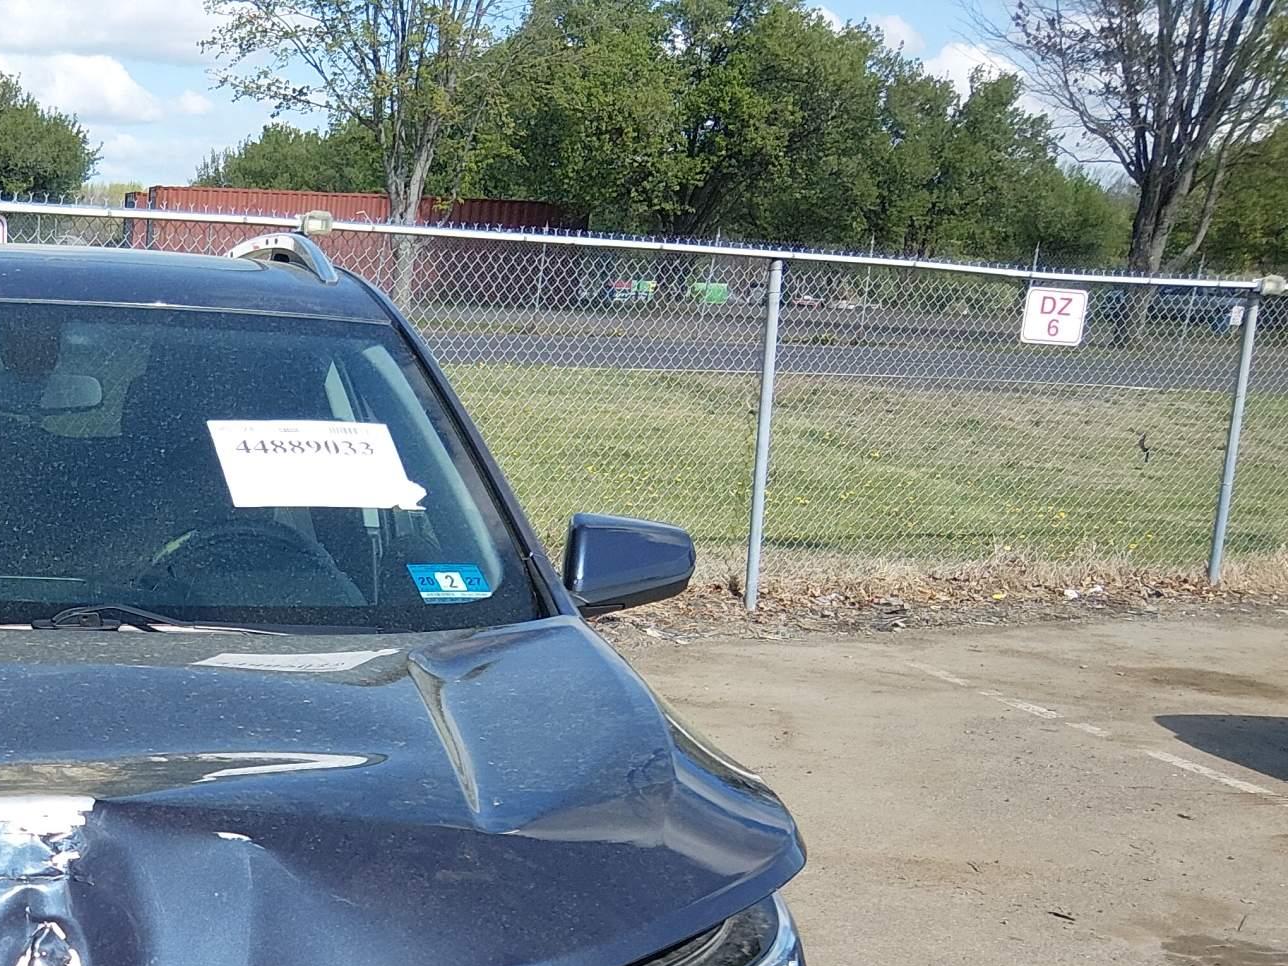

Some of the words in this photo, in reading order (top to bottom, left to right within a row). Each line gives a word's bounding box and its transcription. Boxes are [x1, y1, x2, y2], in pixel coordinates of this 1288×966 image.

[1040, 296, 1073, 316] DZ
[1047, 319, 1059, 337] 6
[235, 439, 374, 456] 44889033
[418, 576, 435, 586] 20
[444, 574, 459, 589] 2
[465, 576, 481, 586] 27
